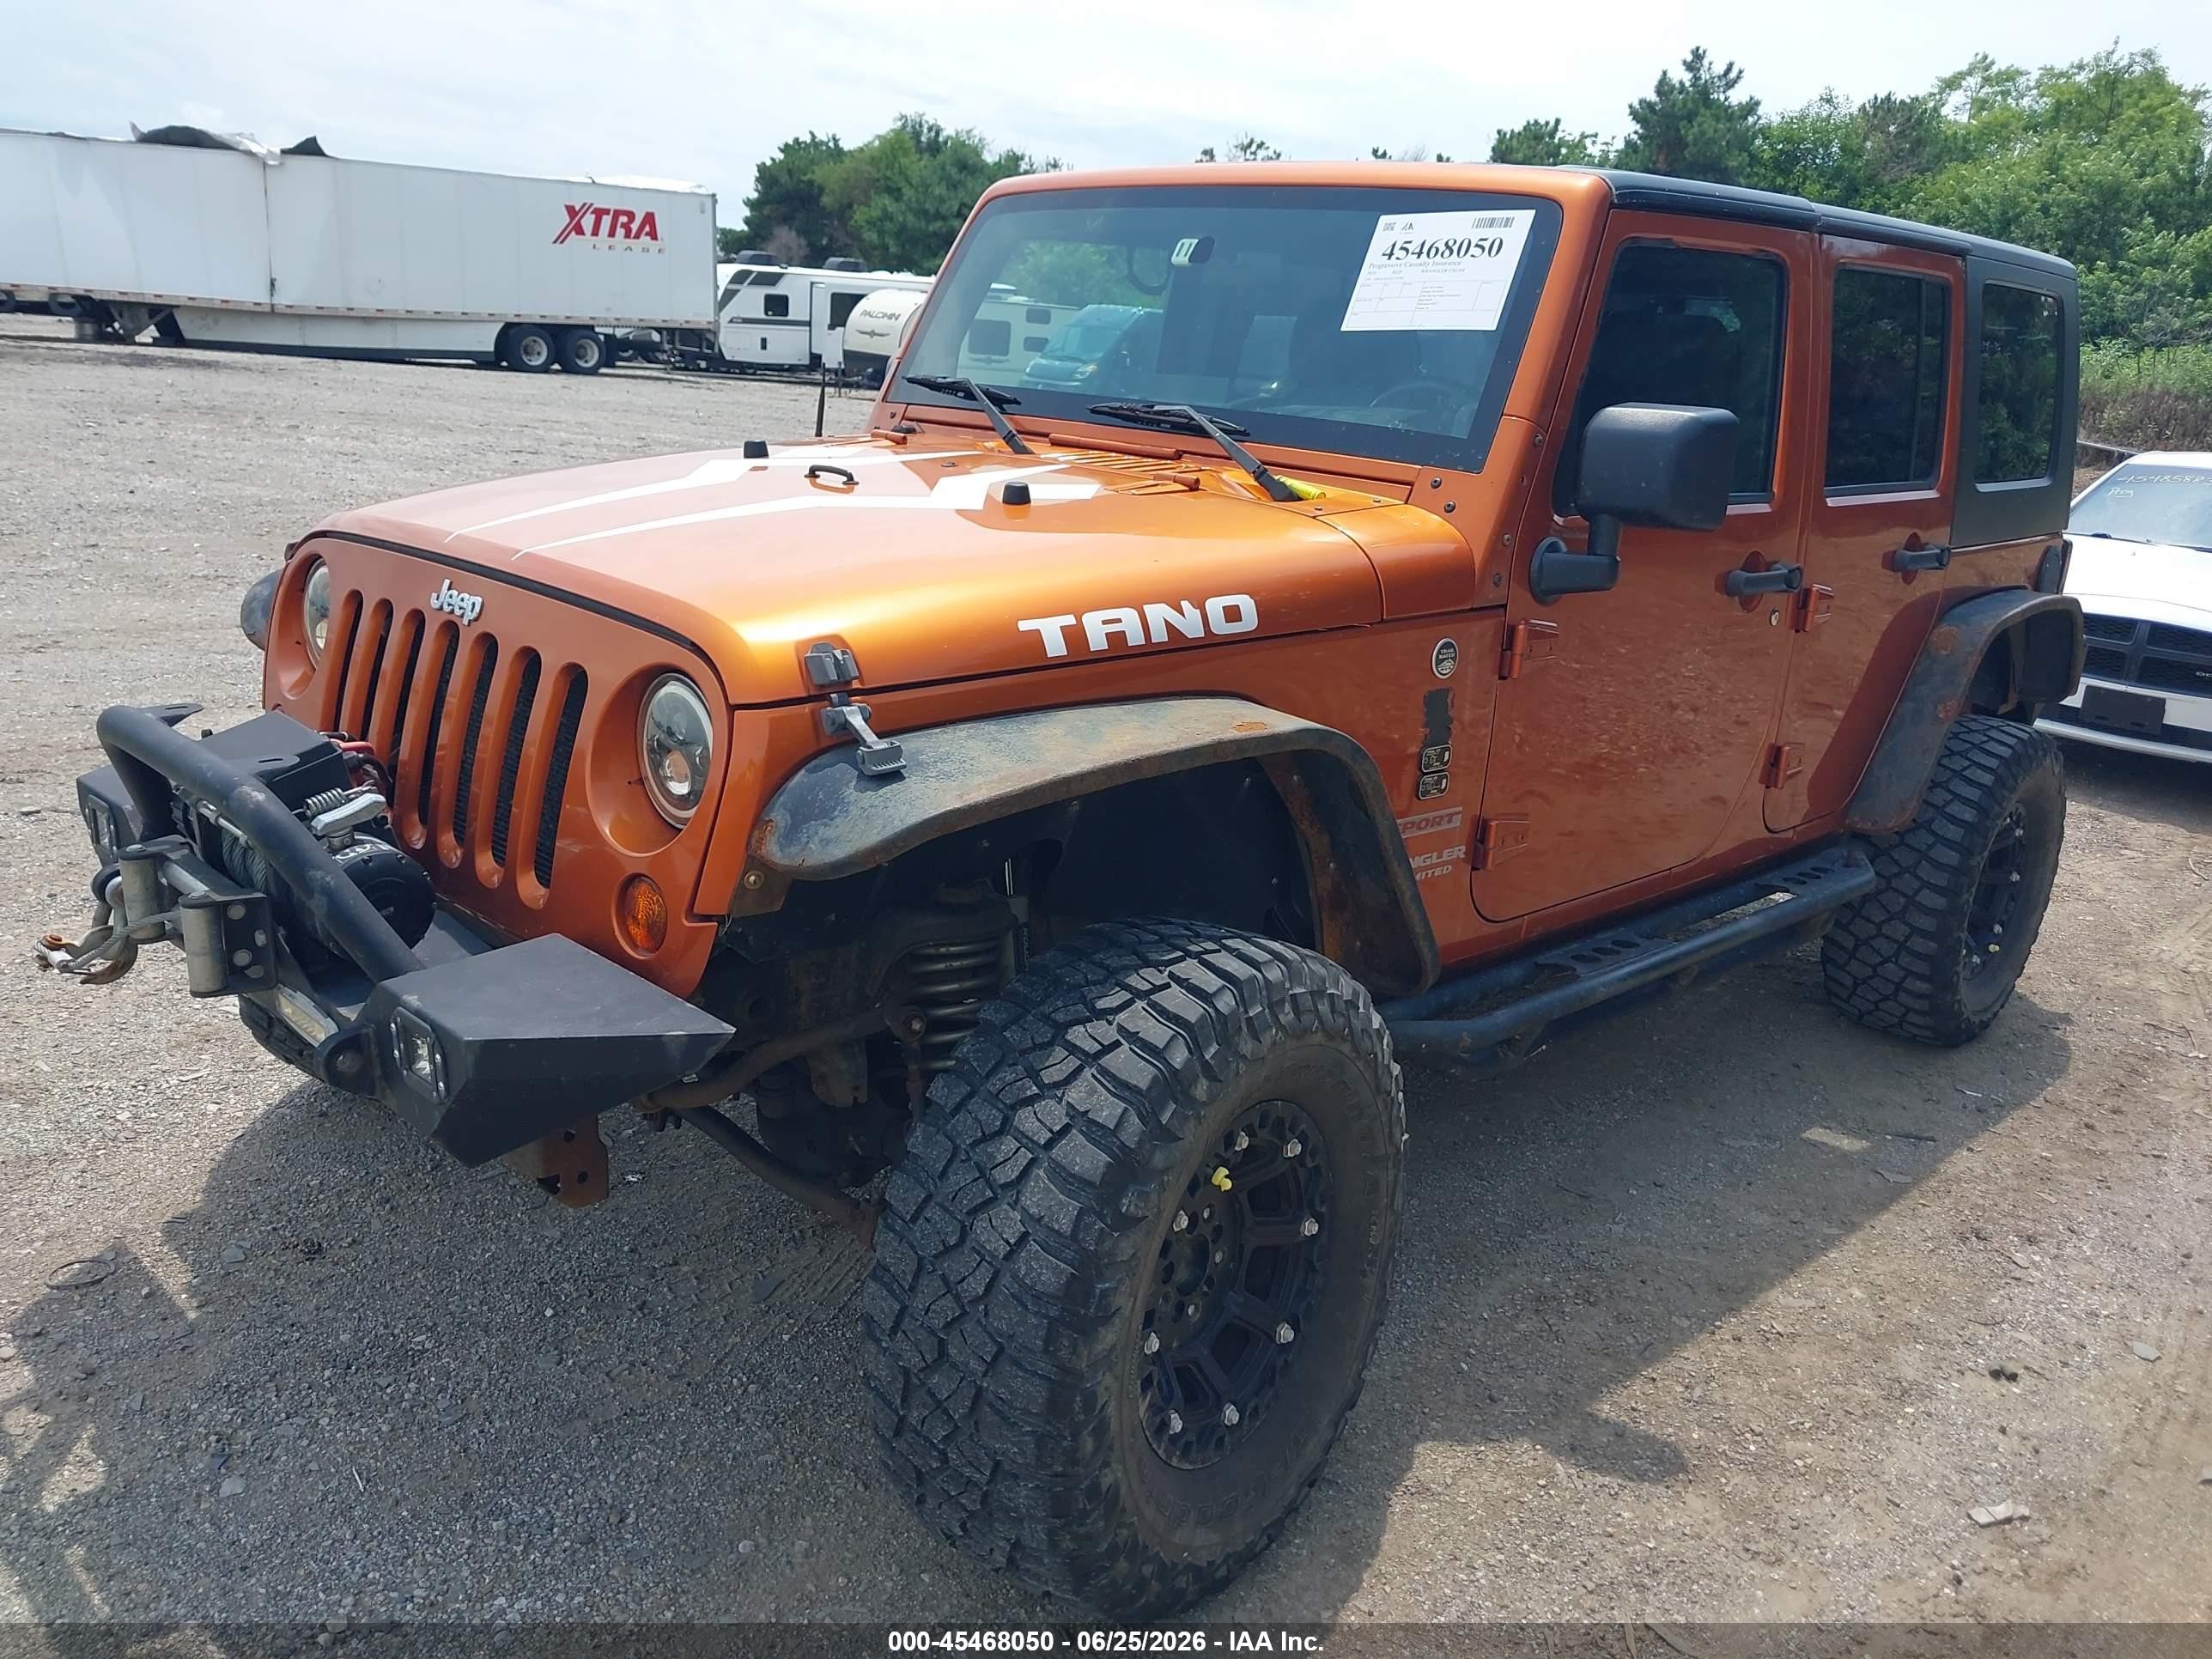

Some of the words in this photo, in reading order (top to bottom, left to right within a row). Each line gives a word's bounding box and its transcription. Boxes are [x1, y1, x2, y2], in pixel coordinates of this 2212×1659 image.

[552, 203, 659, 244] XTRA
[592, 243, 665, 254] LEASE
[1382, 237, 1504, 260] 45468050
[431, 578, 483, 626] Jeep
[1017, 594, 1259, 659] TANO
[1400, 810, 1462, 835] PORT
